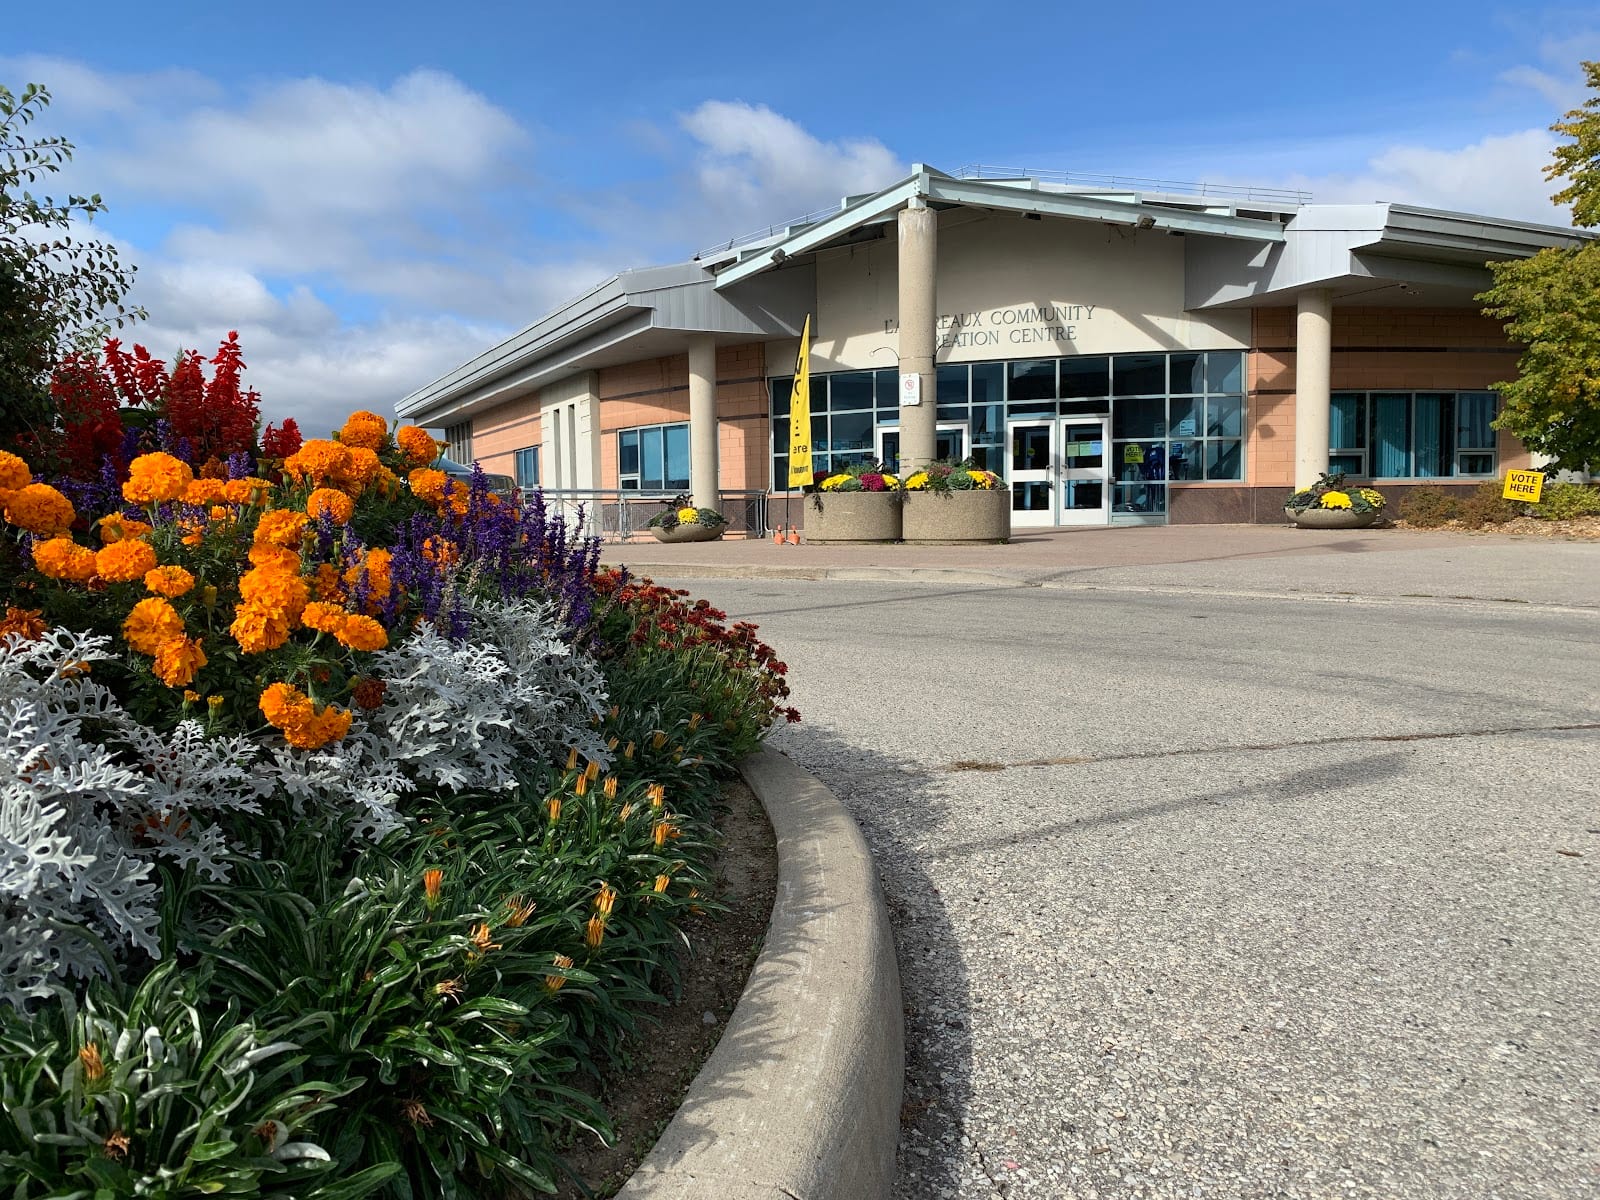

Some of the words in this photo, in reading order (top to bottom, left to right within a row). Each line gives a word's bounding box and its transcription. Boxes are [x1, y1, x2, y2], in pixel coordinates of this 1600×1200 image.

[990, 305, 1096, 325] COMMUNITY
[1009, 326, 1077, 343] CENTRE
[1511, 473, 1538, 484] VOTE
[1510, 483, 1536, 494] HERE
